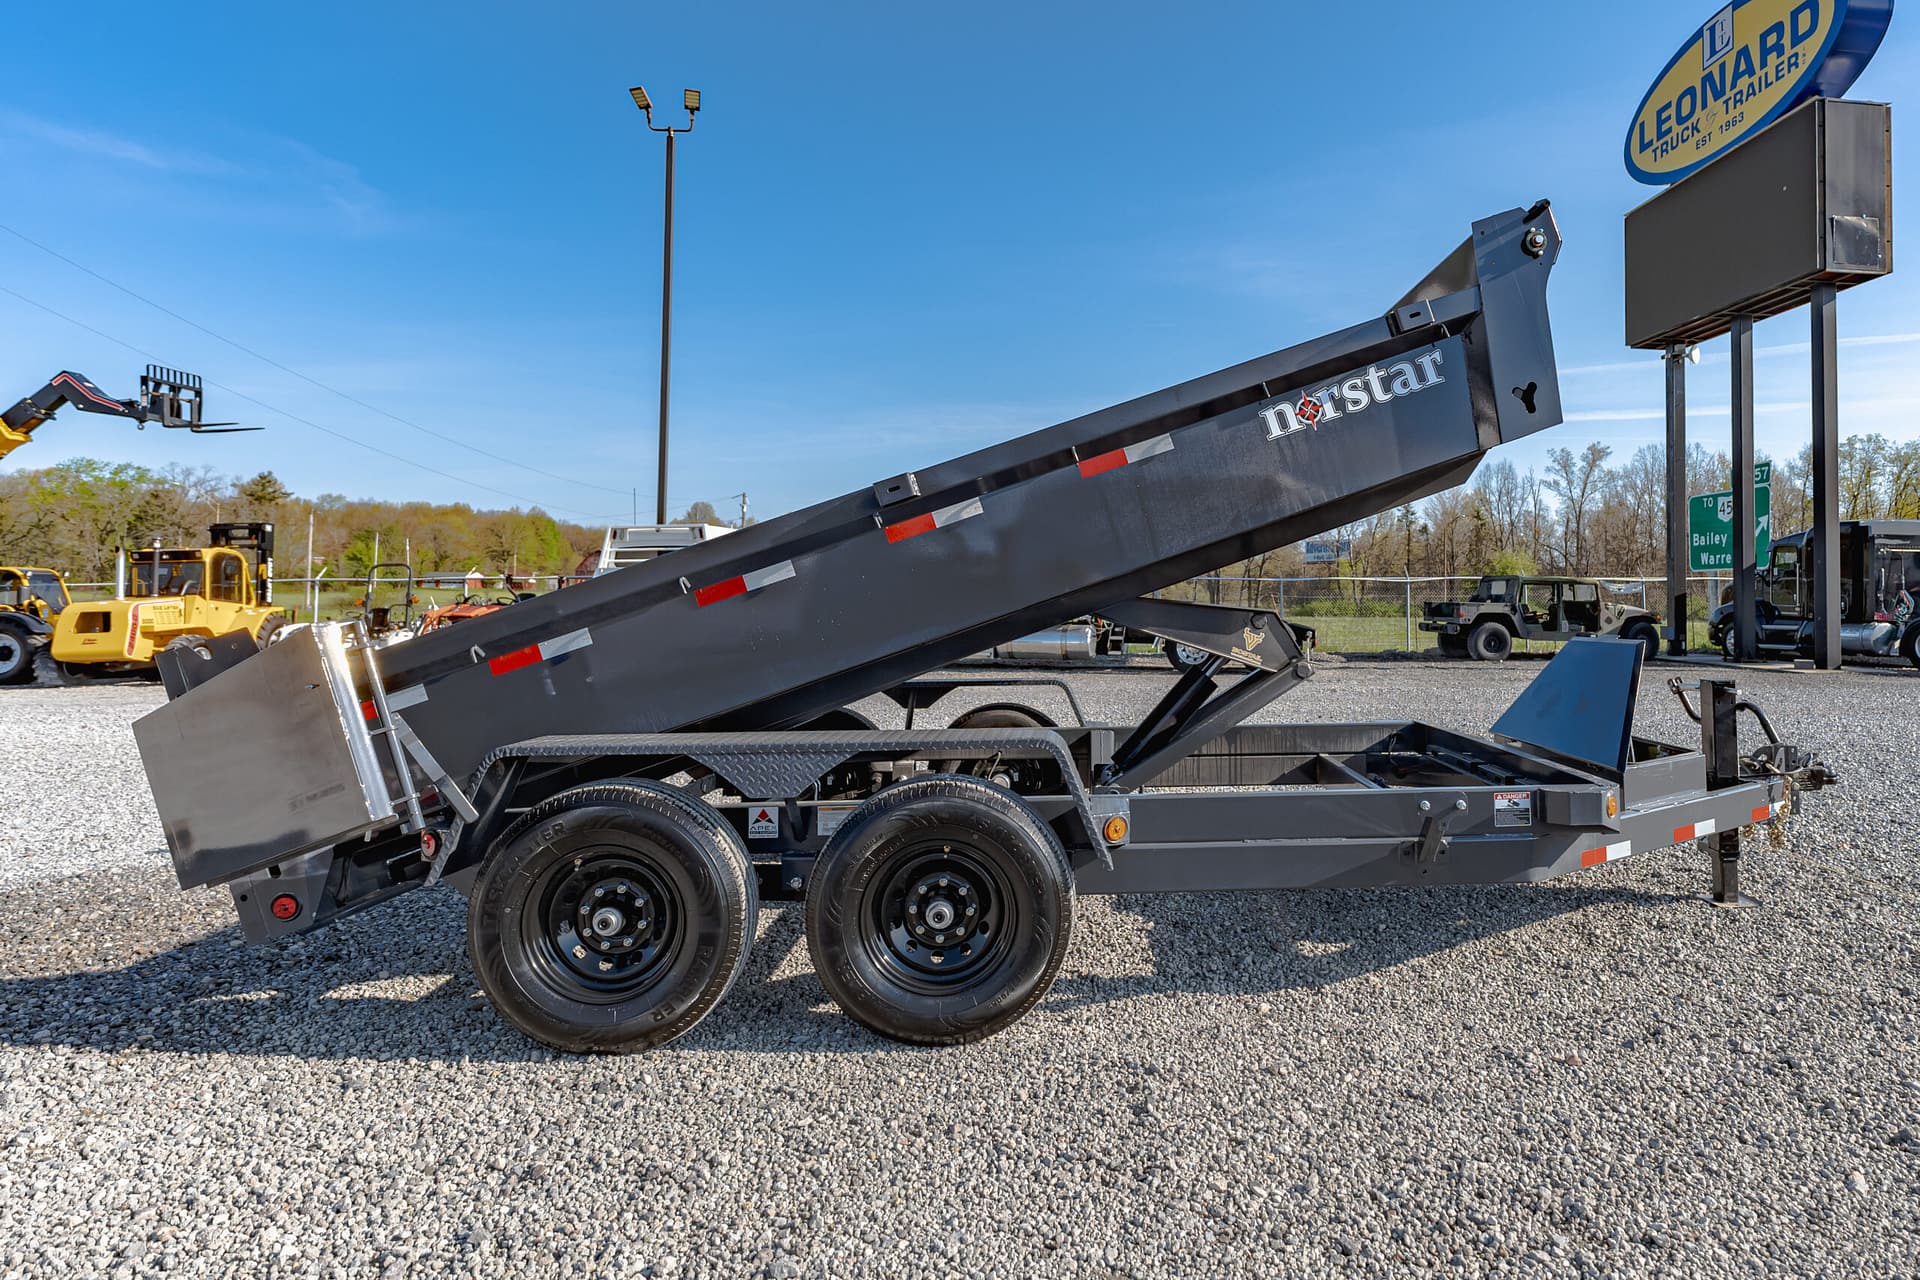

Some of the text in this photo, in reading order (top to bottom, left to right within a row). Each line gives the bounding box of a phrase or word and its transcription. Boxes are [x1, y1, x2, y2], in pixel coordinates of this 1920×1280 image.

[1639, 0, 1820, 154] LEONARD
[1652, 118, 1701, 163] TRUCK
[1723, 51, 1799, 115] TRAILER
[1695, 111, 1744, 150] EST 1963
[1258, 349, 1446, 441] norstar
[1754, 466, 1769, 481] 57
[1703, 498, 1713, 507] TO
[1693, 532, 1727, 547] Bailey
[1701, 552, 1732, 565] Warre
